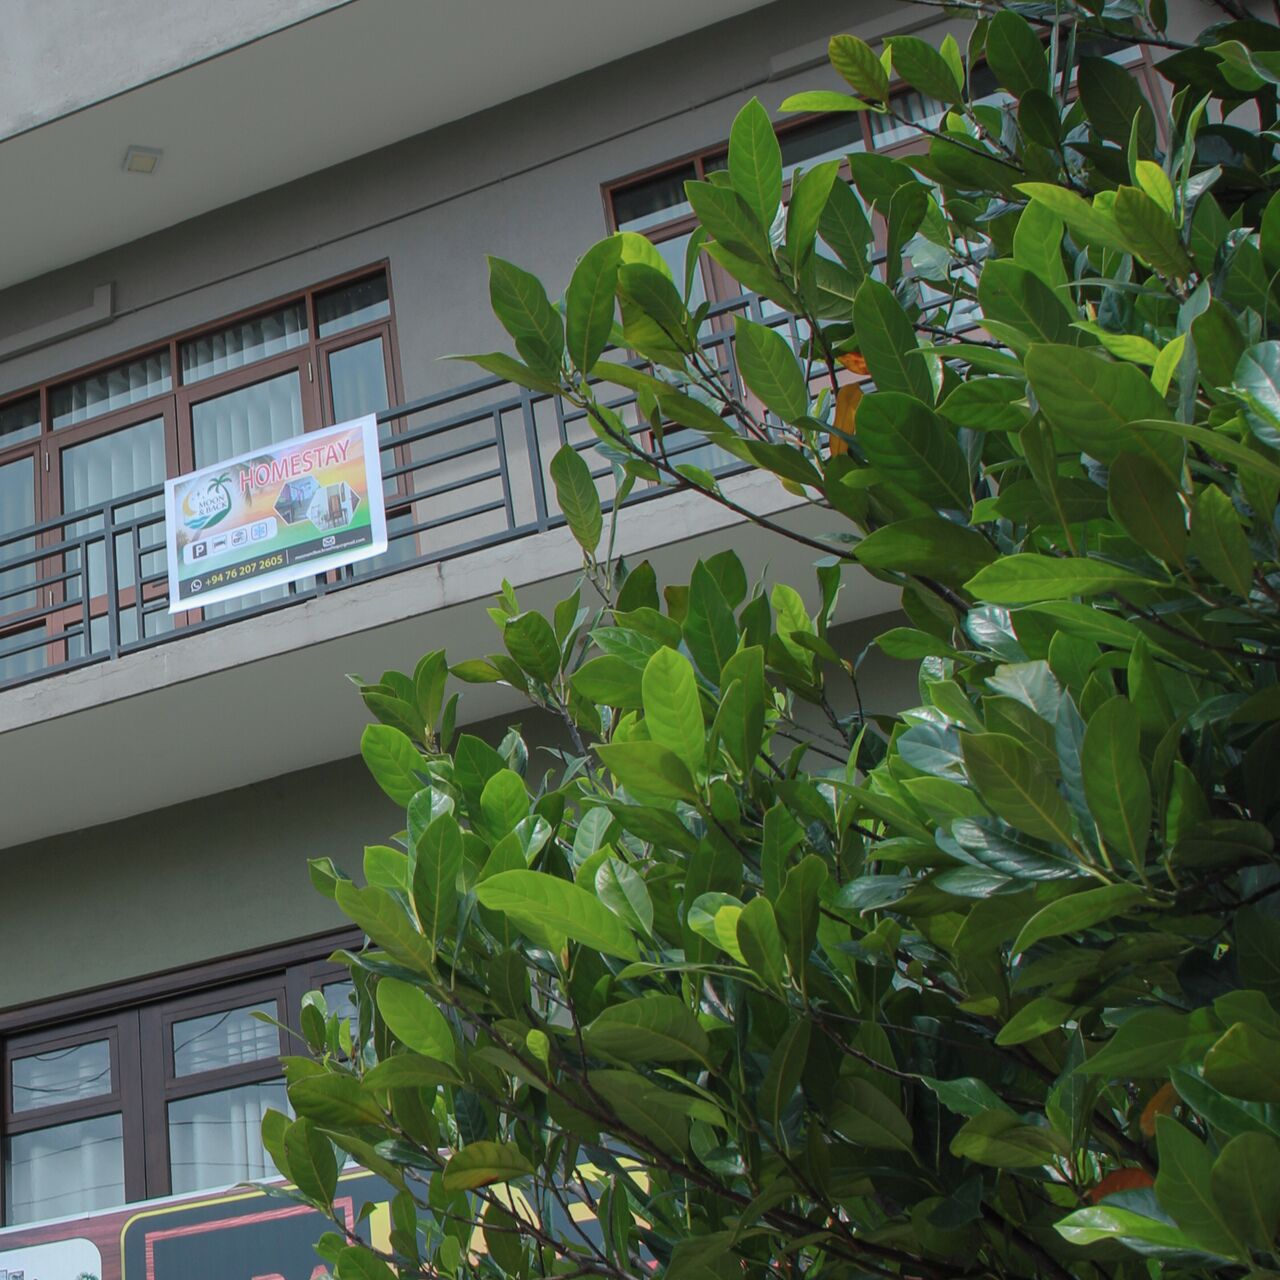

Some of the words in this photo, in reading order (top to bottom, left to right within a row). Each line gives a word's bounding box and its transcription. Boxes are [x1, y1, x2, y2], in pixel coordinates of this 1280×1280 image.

[239, 438, 351, 493] HOMESTAY
[199, 495, 225, 509] MOON
[205, 502, 228, 514] BACK
[195, 545, 204, 556] P
[205, 573, 224, 586] +94
[225, 568, 238, 580] 76
[239, 562, 257, 576] 207
[259, 555, 283, 570] 2605
